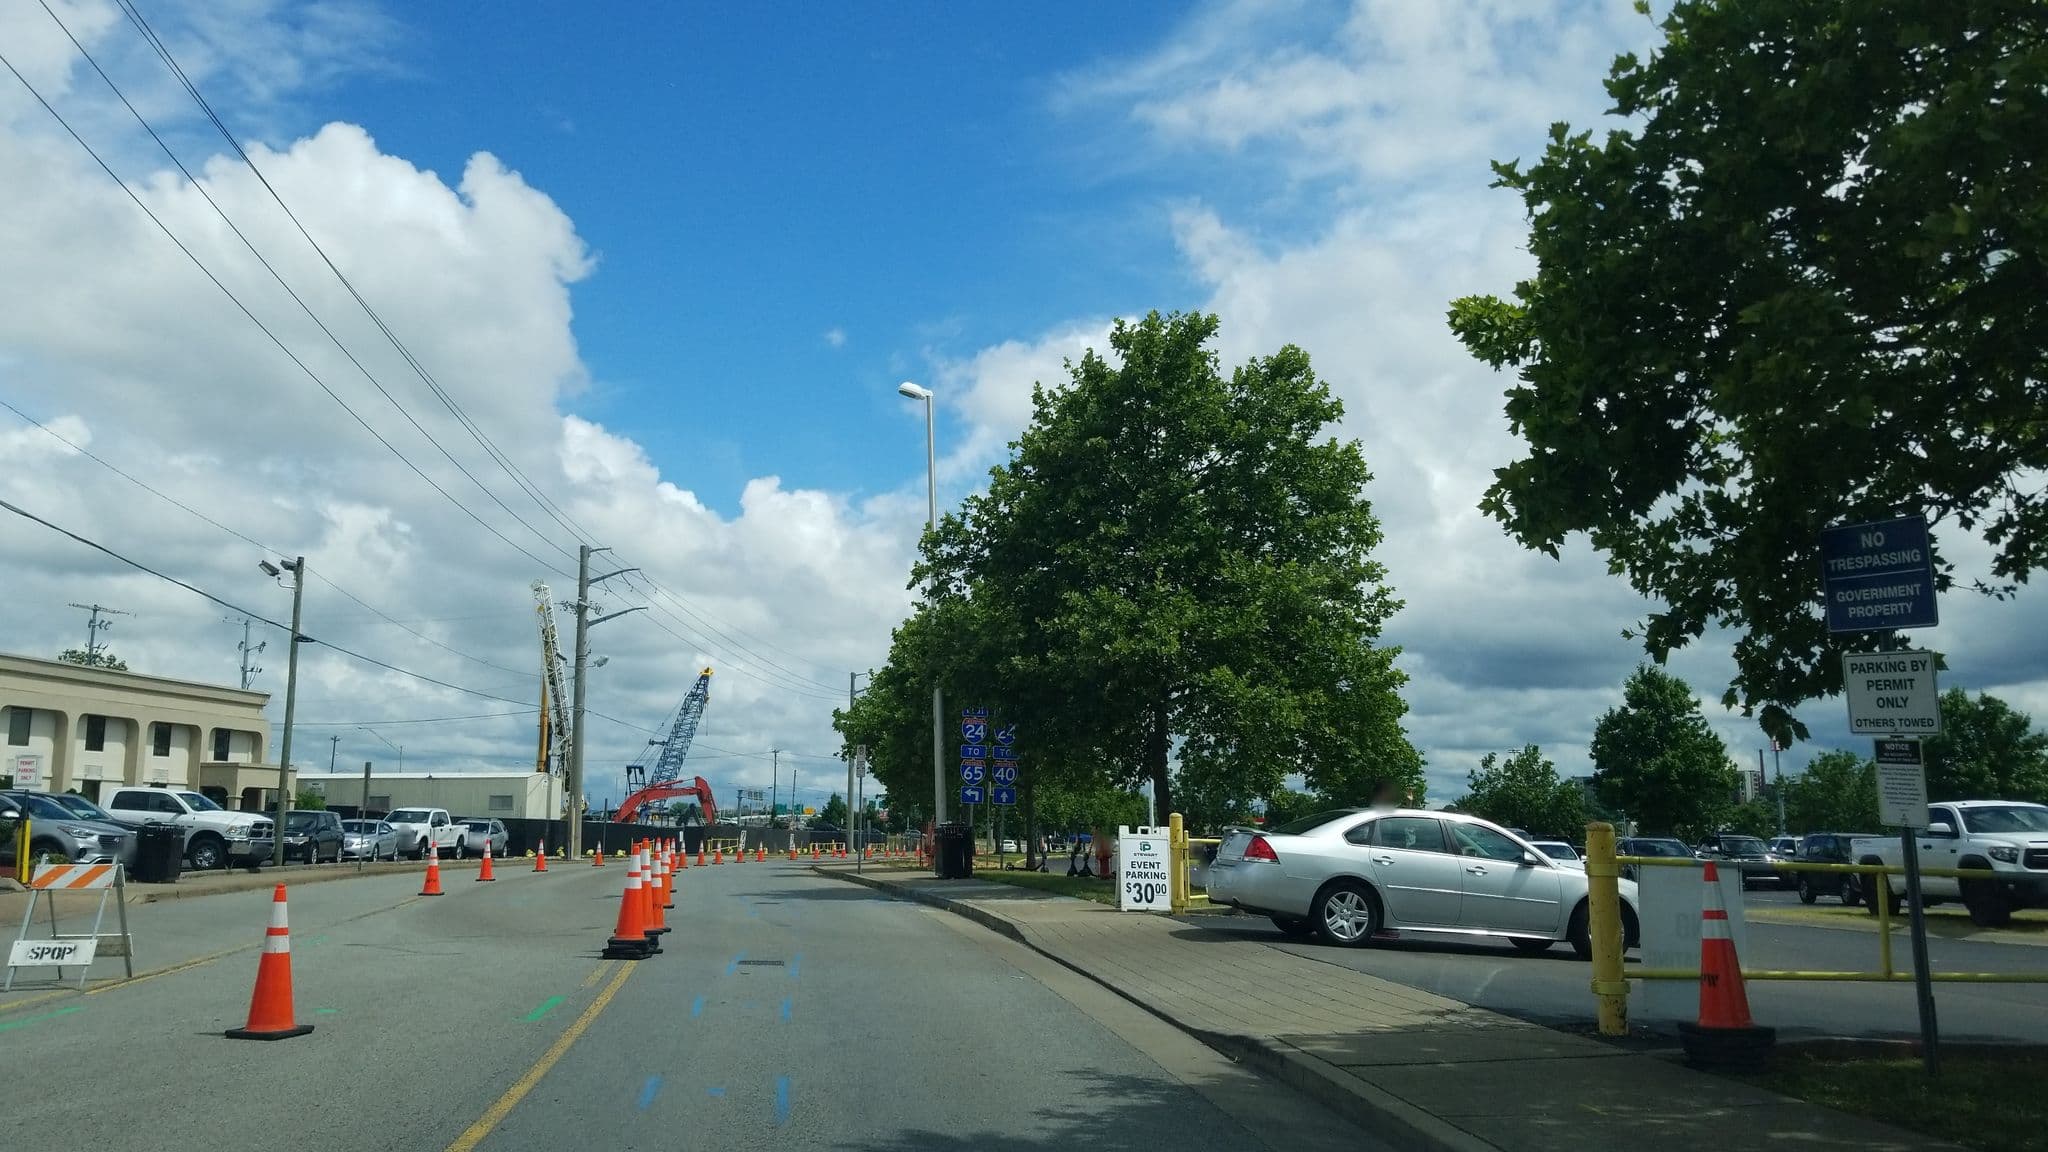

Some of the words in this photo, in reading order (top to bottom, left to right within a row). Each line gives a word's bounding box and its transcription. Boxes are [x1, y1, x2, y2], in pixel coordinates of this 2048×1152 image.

[1860, 531, 1885, 548] NO
[1828, 549, 1921, 571] TRESPASSING
[1836, 583, 1921, 602] GOVERNMENT
[1848, 602, 1913, 618] PROPERTY
[1850, 660, 1907, 674] PARKING
[1910, 660, 1927, 672] BY
[1866, 678, 1915, 691] PERMIT
[1876, 696, 1909, 709] ONLY
[1855, 718, 1895, 728] OTHERS
[1897, 717, 1935, 728] TOWED
[965, 724, 985, 739] 24
[967, 747, 980, 756] TO
[964, 766, 983, 780] 65
[995, 767, 1015, 781] 40
[1130, 861, 1161, 869] EVENT
[1126, 871, 1167, 880] PARKING
